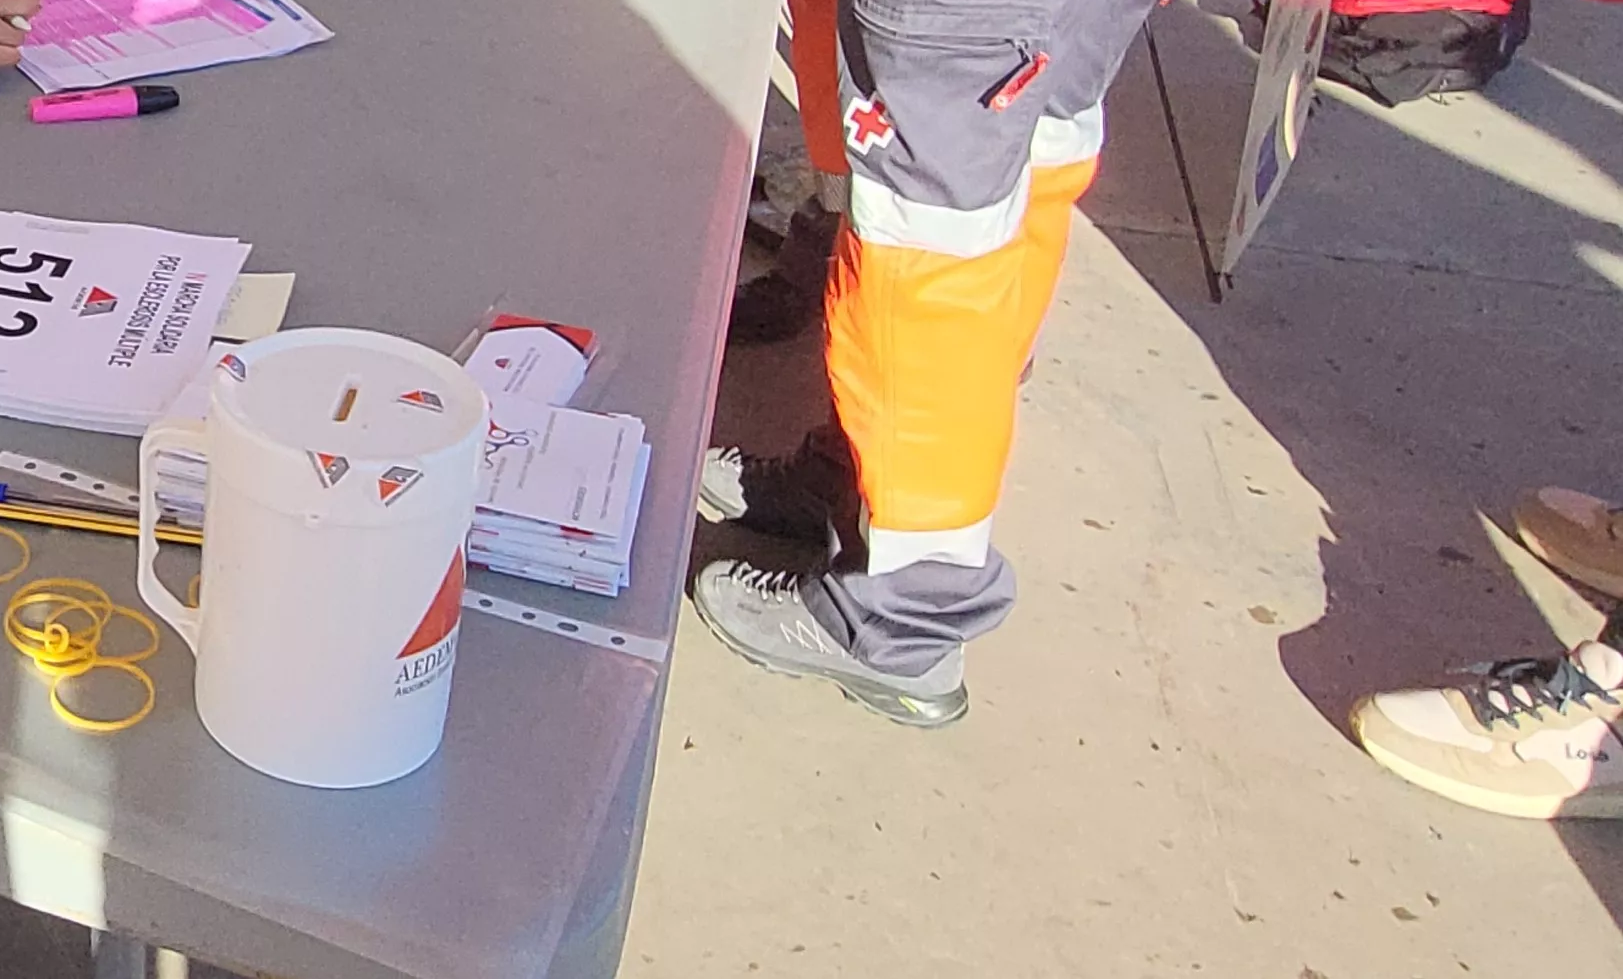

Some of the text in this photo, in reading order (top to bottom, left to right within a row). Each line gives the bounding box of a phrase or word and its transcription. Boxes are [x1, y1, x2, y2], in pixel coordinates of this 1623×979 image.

[156, 254, 181, 271] POR
[126, 281, 169, 328] ESCLEROSIS
[172, 282, 204, 314] MARCHA
[150, 314, 191, 354] SOLIDARIA
